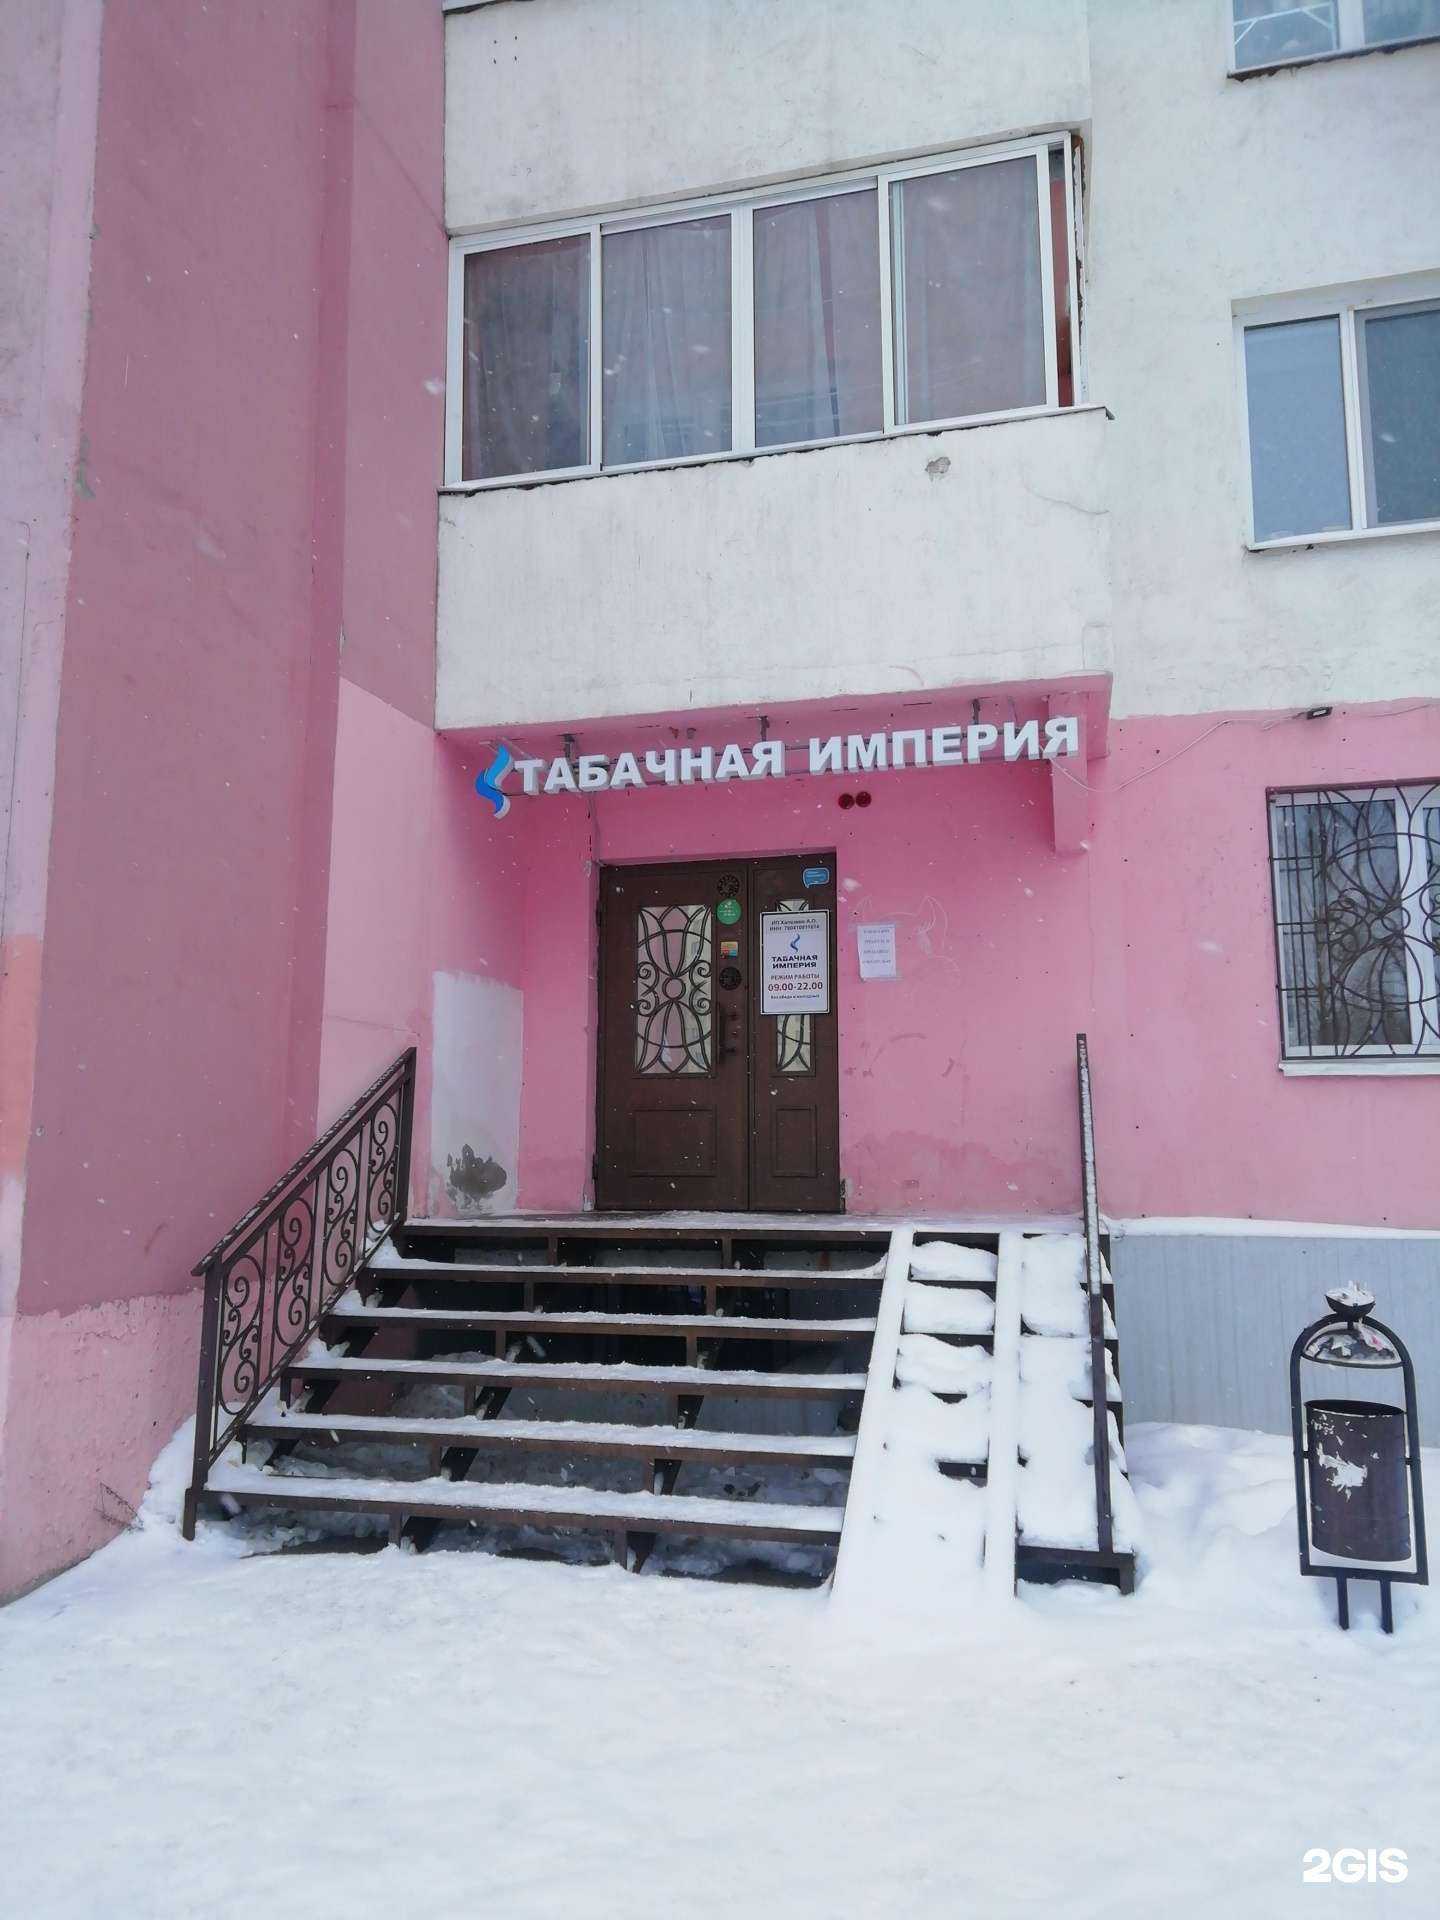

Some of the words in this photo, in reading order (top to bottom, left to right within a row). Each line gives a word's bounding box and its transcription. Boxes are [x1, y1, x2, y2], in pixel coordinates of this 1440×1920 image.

[514, 741, 785, 795] ТАБАЧНАЯ
[808, 716, 1080, 774] ИМПЕРИЯ
[768, 982, 823, 991] 09.00-22.00
